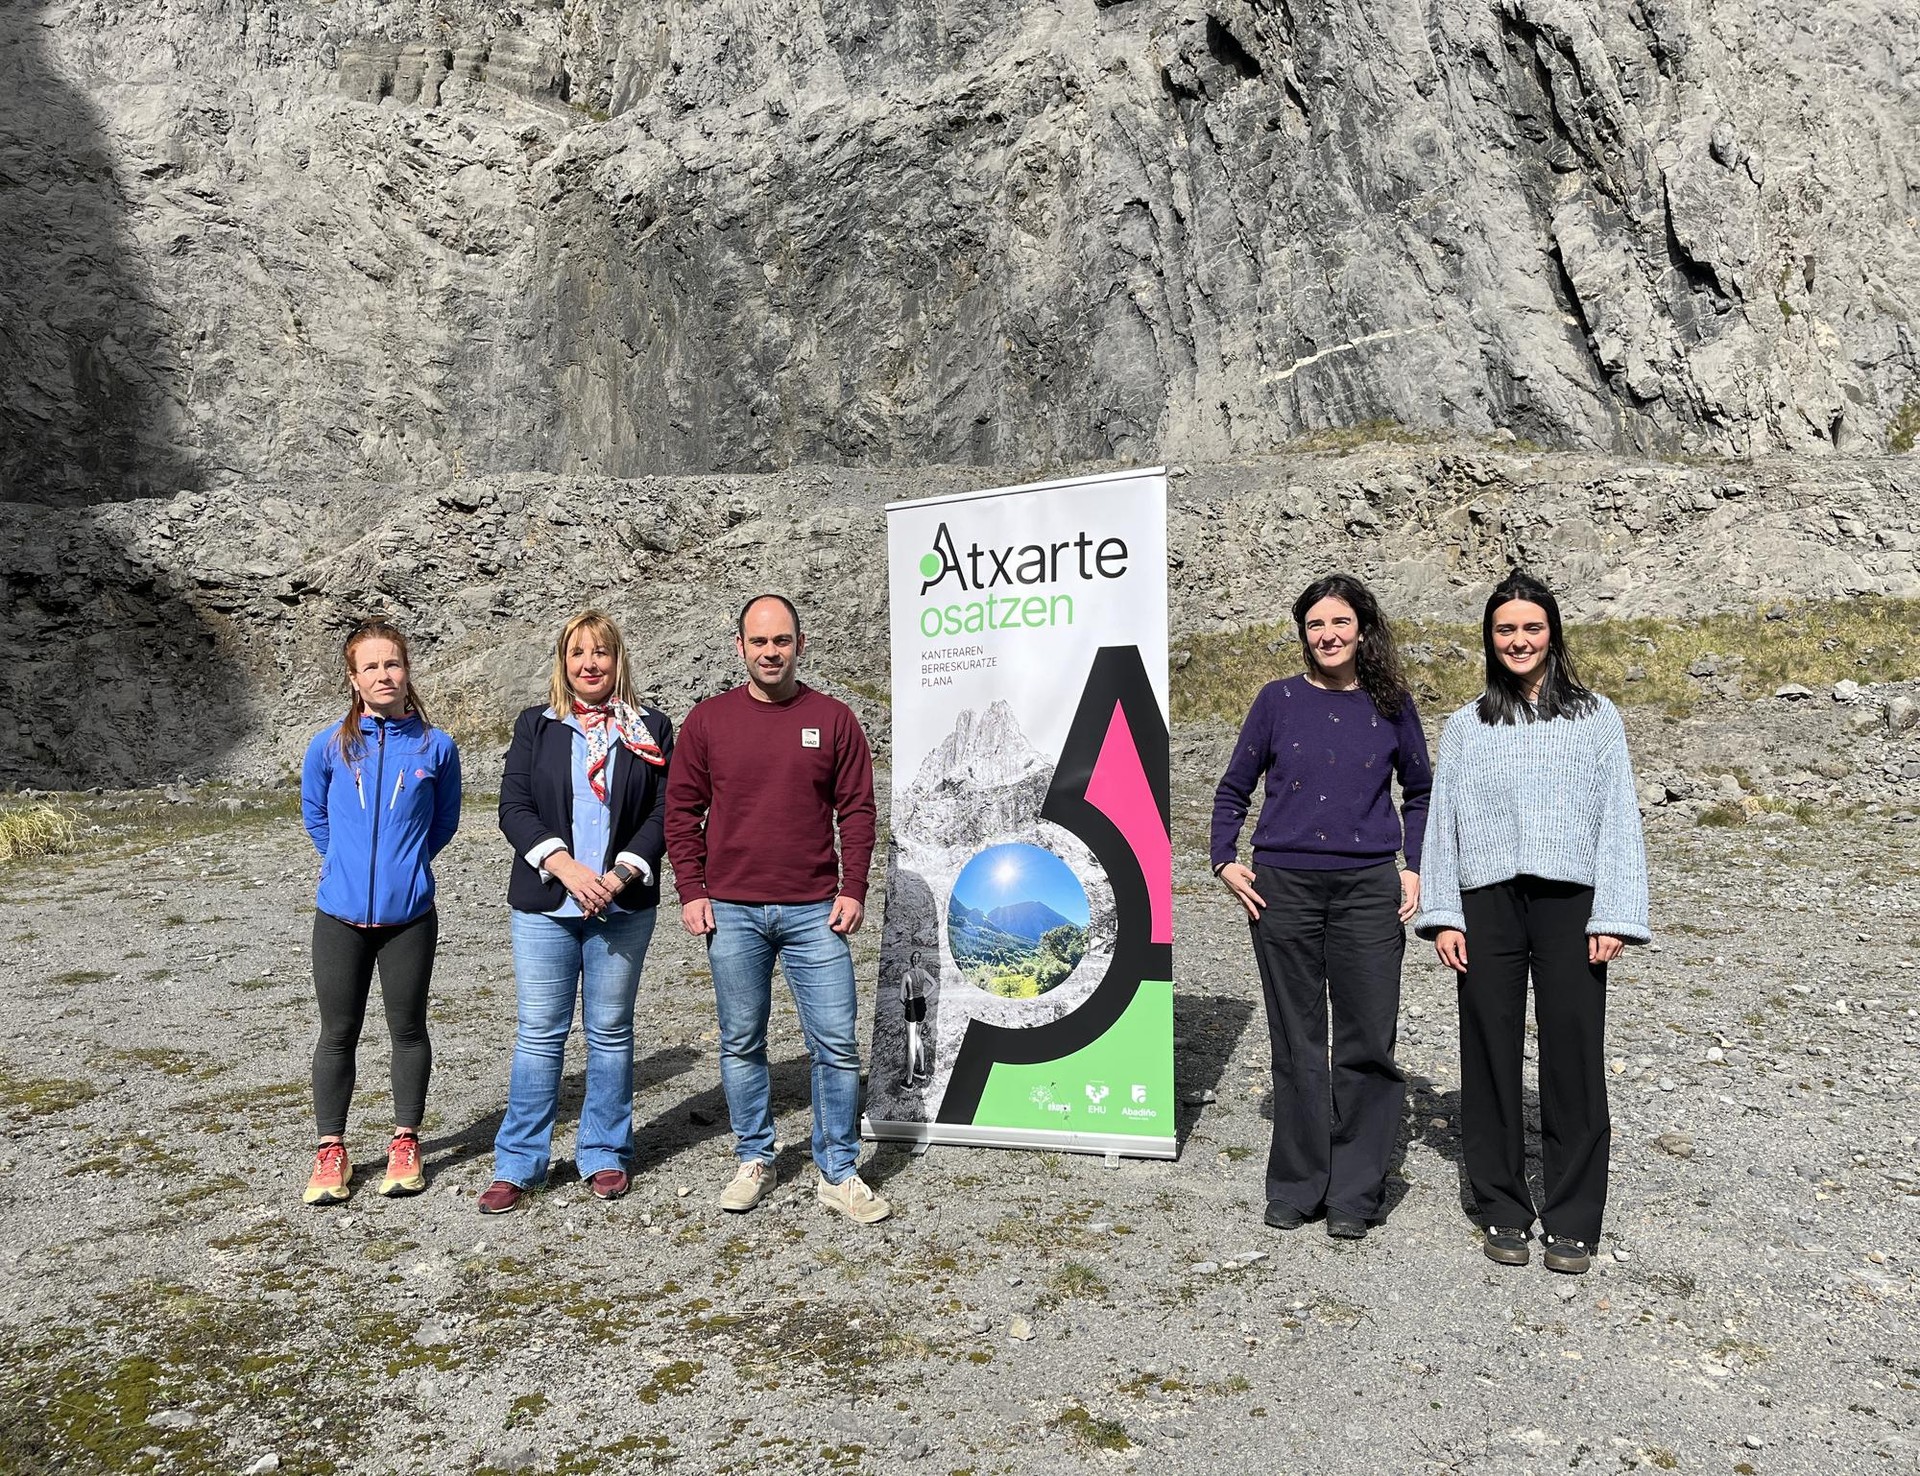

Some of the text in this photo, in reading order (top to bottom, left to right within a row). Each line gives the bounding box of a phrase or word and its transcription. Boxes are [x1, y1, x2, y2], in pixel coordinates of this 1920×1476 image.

[920, 522, 1128, 596] Atxarte
[920, 593, 1074, 638] osatzen
[921, 645, 984, 661] KANTERAREN
[921, 656, 998, 675] BERRESKURATZE
[921, 676, 953, 688] PLANA
[1088, 1105, 1107, 1115] EHU
